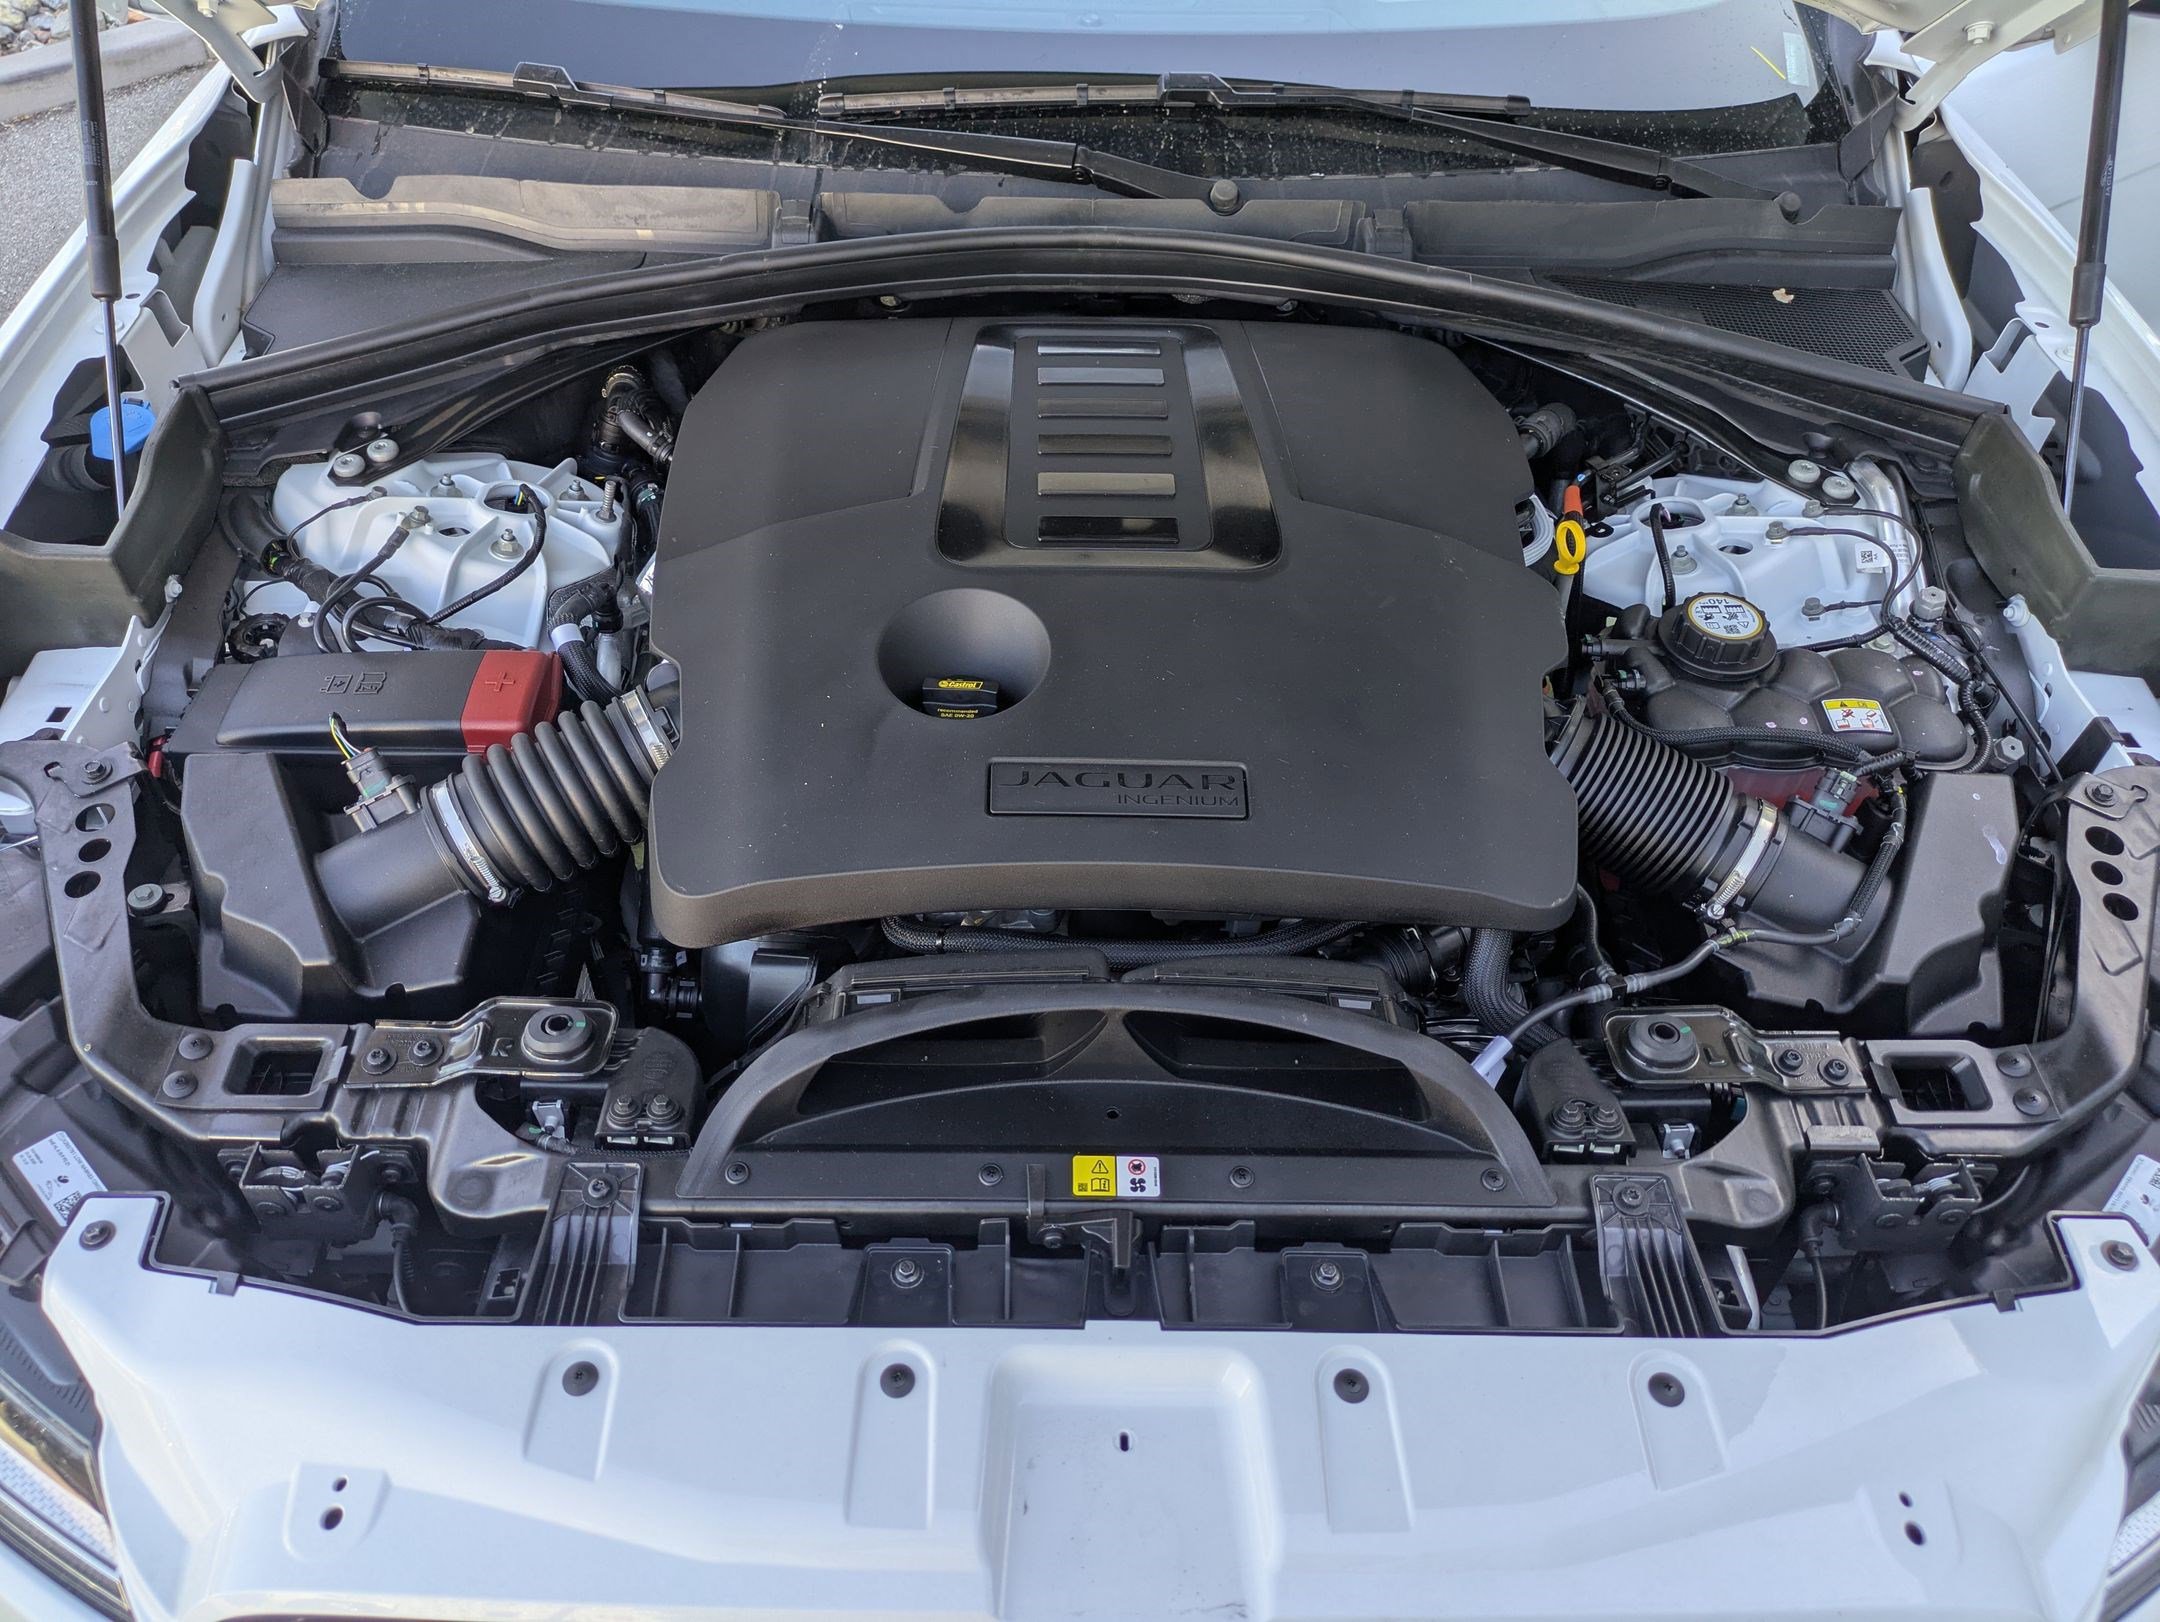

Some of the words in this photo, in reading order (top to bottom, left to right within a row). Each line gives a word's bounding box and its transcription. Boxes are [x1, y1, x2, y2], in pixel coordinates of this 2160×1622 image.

[948, 681, 976, 689] Castrol
[1000, 771, 1236, 790] JAGUAR
[1117, 795, 1239, 806] INGENIUM
